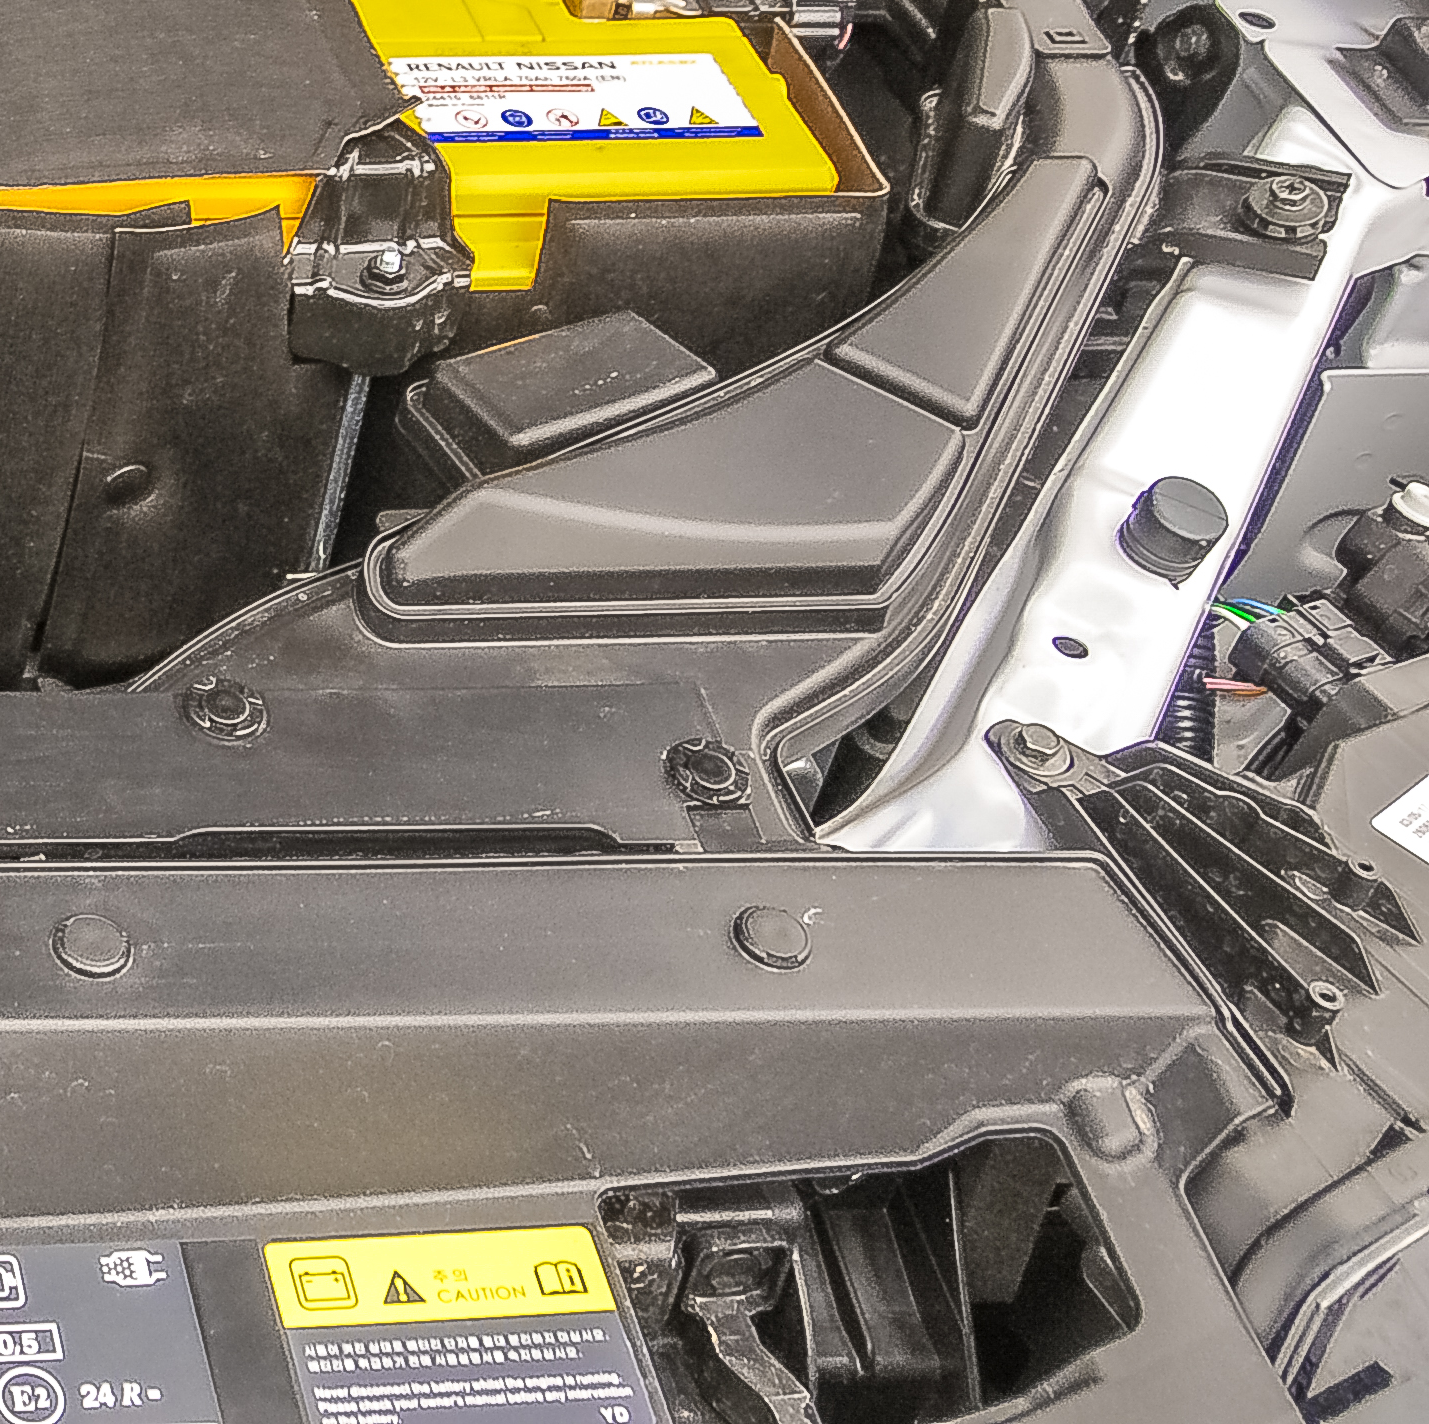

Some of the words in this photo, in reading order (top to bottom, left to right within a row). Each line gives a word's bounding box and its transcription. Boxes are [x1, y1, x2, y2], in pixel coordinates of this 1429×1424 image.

[406, 62, 505, 71] RENAULT
[516, 61, 617, 71] NISSAN
[432, 1268, 469, 1284] 주의
[437, 1285, 527, 1304] CAUTION
[411, 1381, 431, 1395] the
[430, 1379, 471, 1395] battery
[505, 1376, 525, 1389] the
[524, 1375, 564, 1390] engine
[564, 1374, 577, 1386] is
[9, 1384, 51, 1413] E2
[78, 1381, 117, 1409] 24
[120, 1380, 143, 1408] R
